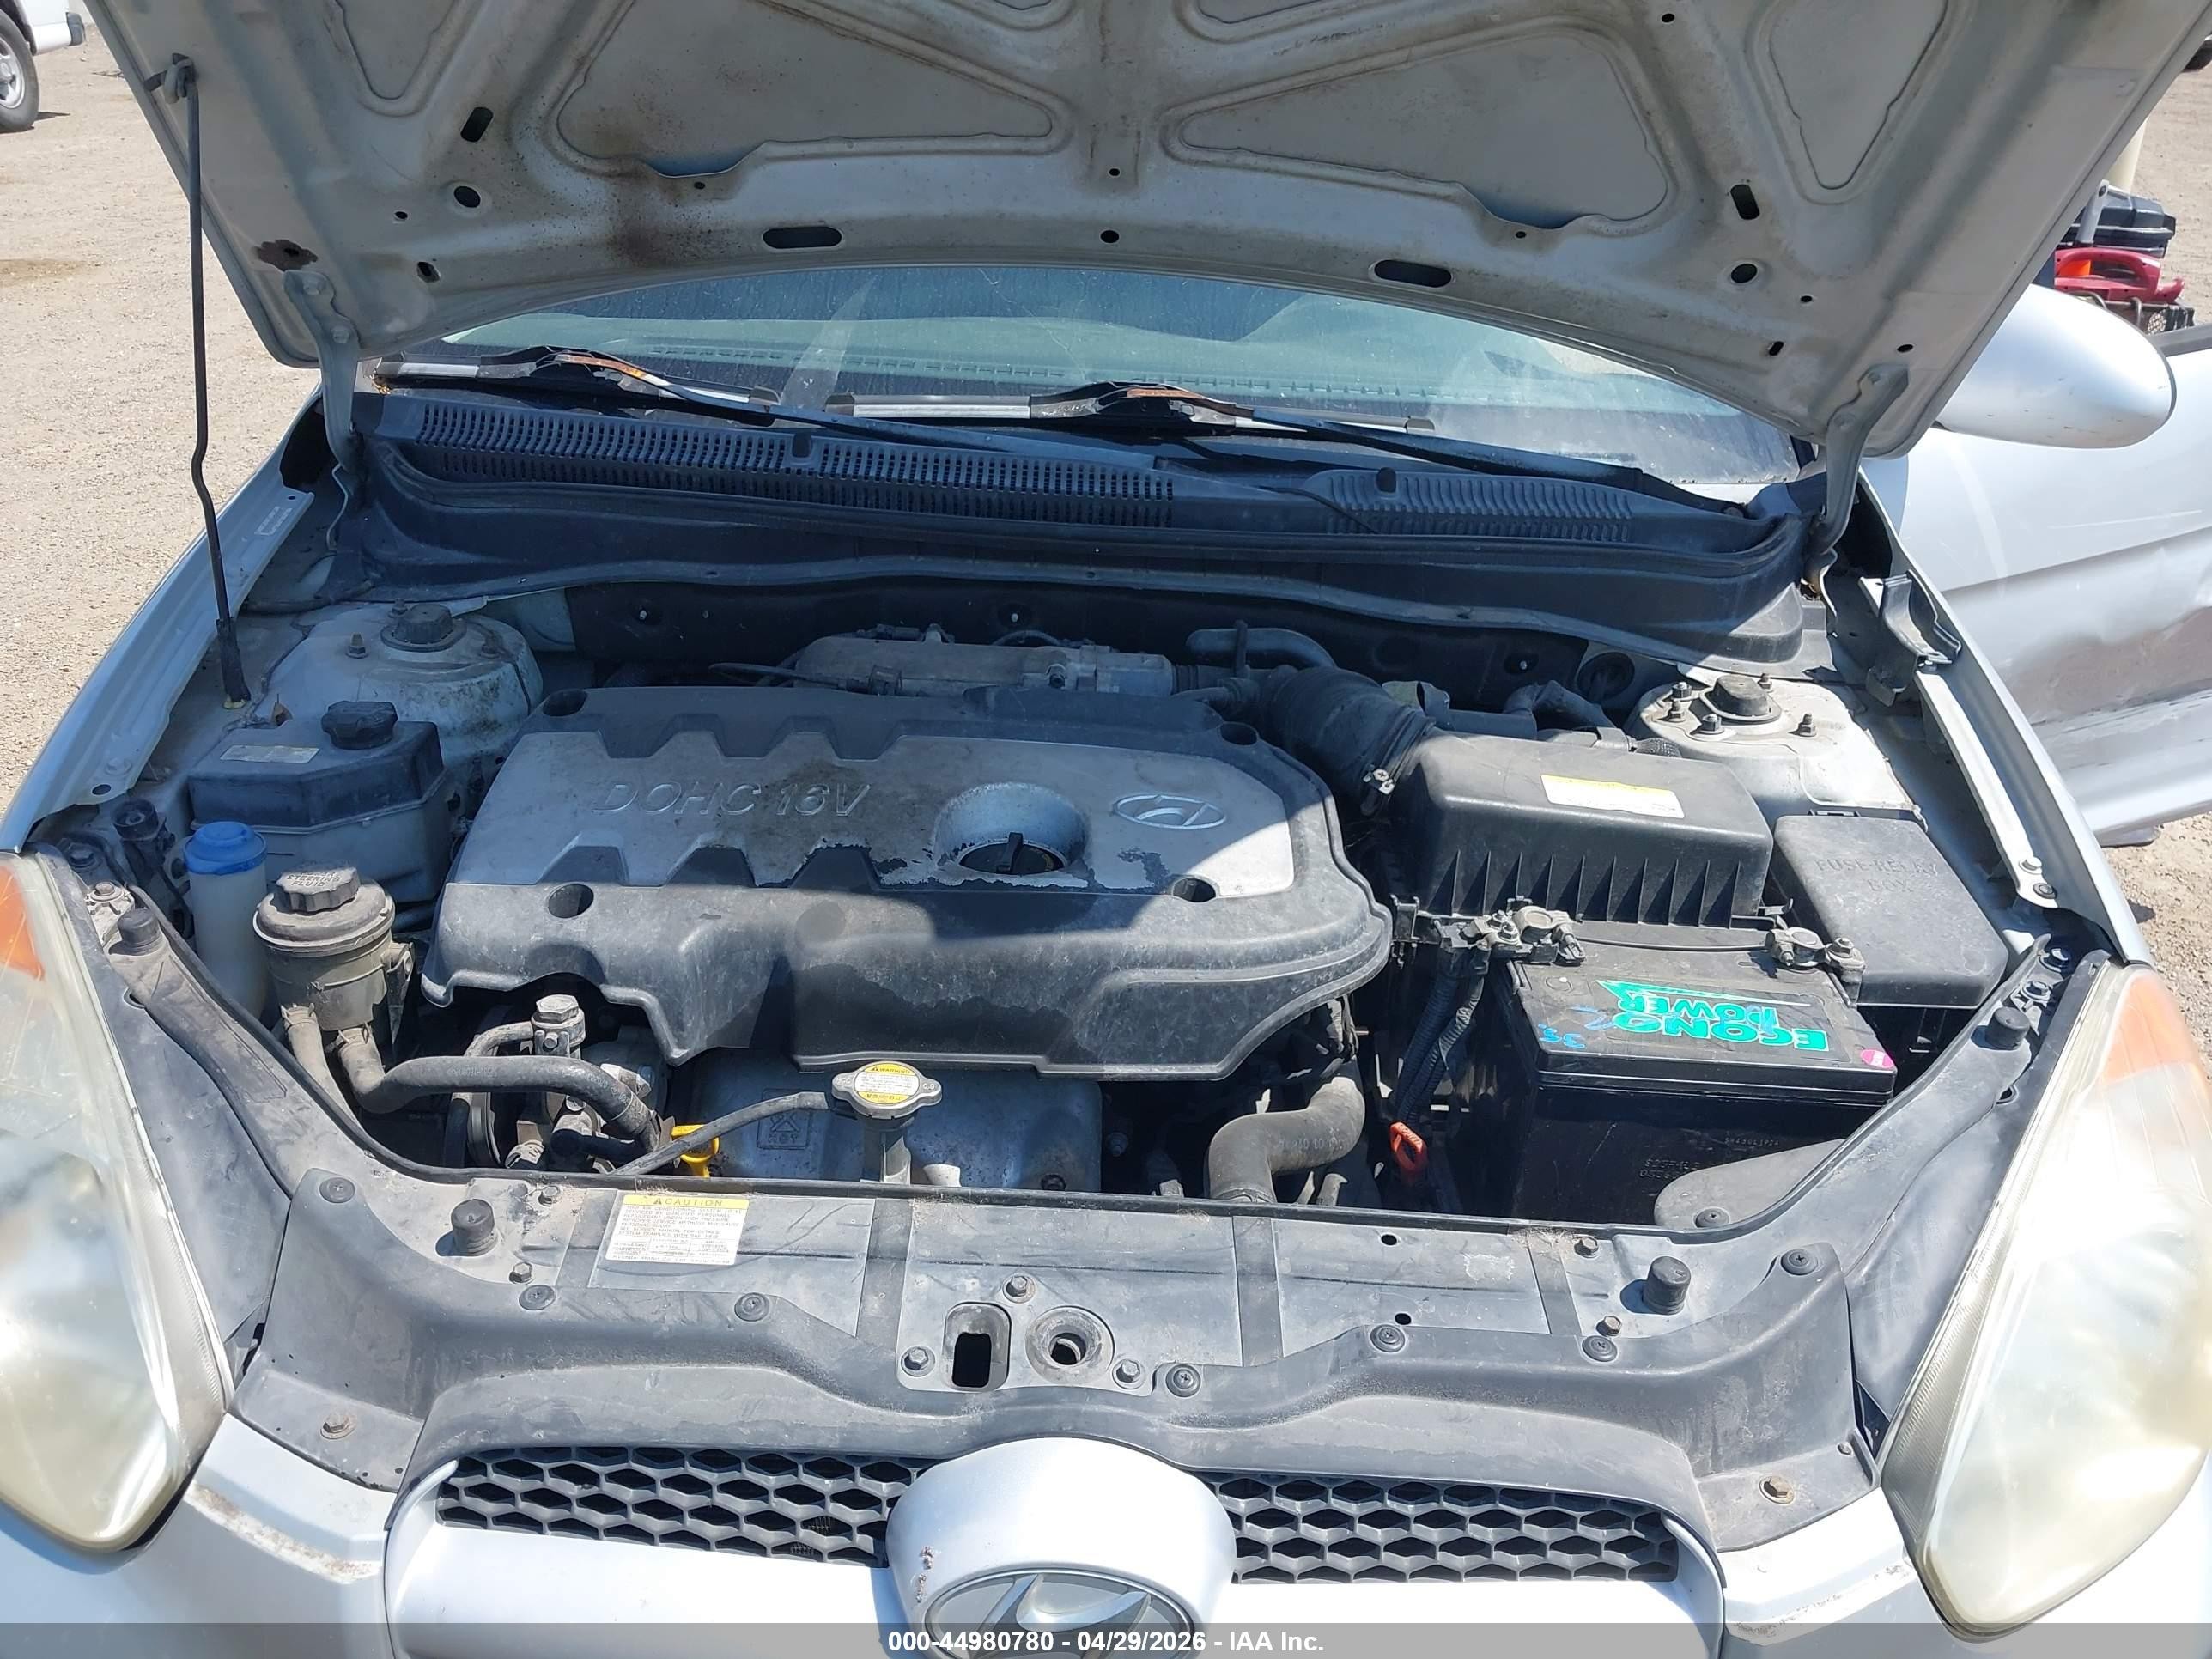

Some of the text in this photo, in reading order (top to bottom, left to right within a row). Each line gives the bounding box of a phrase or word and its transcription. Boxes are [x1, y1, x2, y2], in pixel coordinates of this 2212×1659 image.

[592, 781, 872, 816] DOHC 16V
[286, 874, 341, 883] STEERING
[1617, 994, 1780, 1029] POWER
[1612, 1012, 1830, 1051] ECONO
